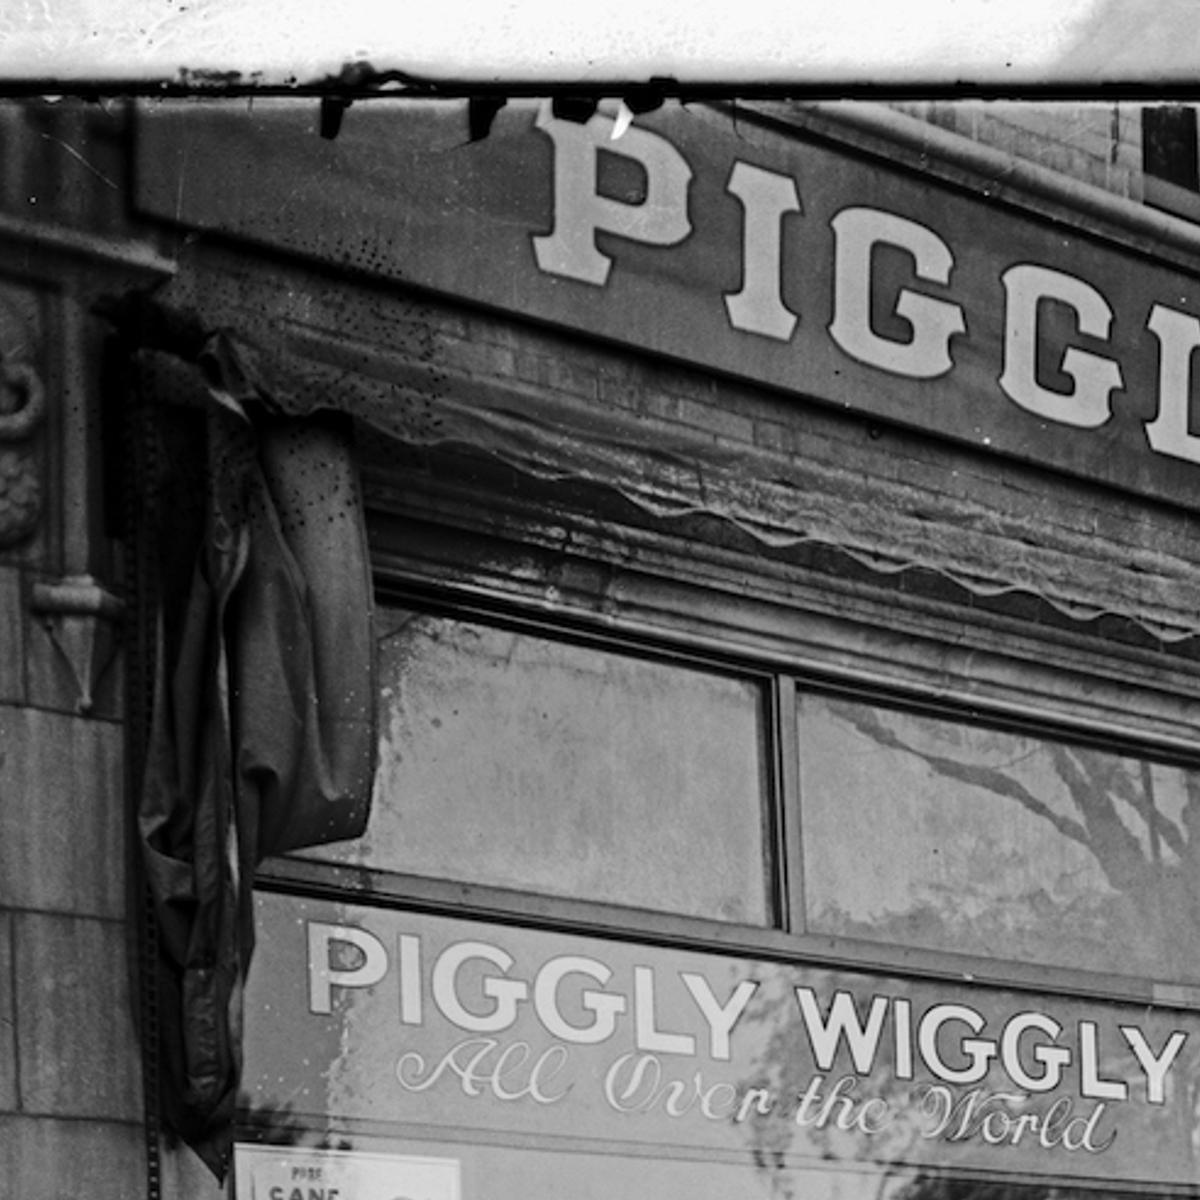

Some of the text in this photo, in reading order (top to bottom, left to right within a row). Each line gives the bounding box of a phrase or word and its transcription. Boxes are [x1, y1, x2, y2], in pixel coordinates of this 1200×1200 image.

[307, 921, 1190, 1105] PIGGLY WIGGLY
[396, 1037, 1118, 1153] All Over the World
